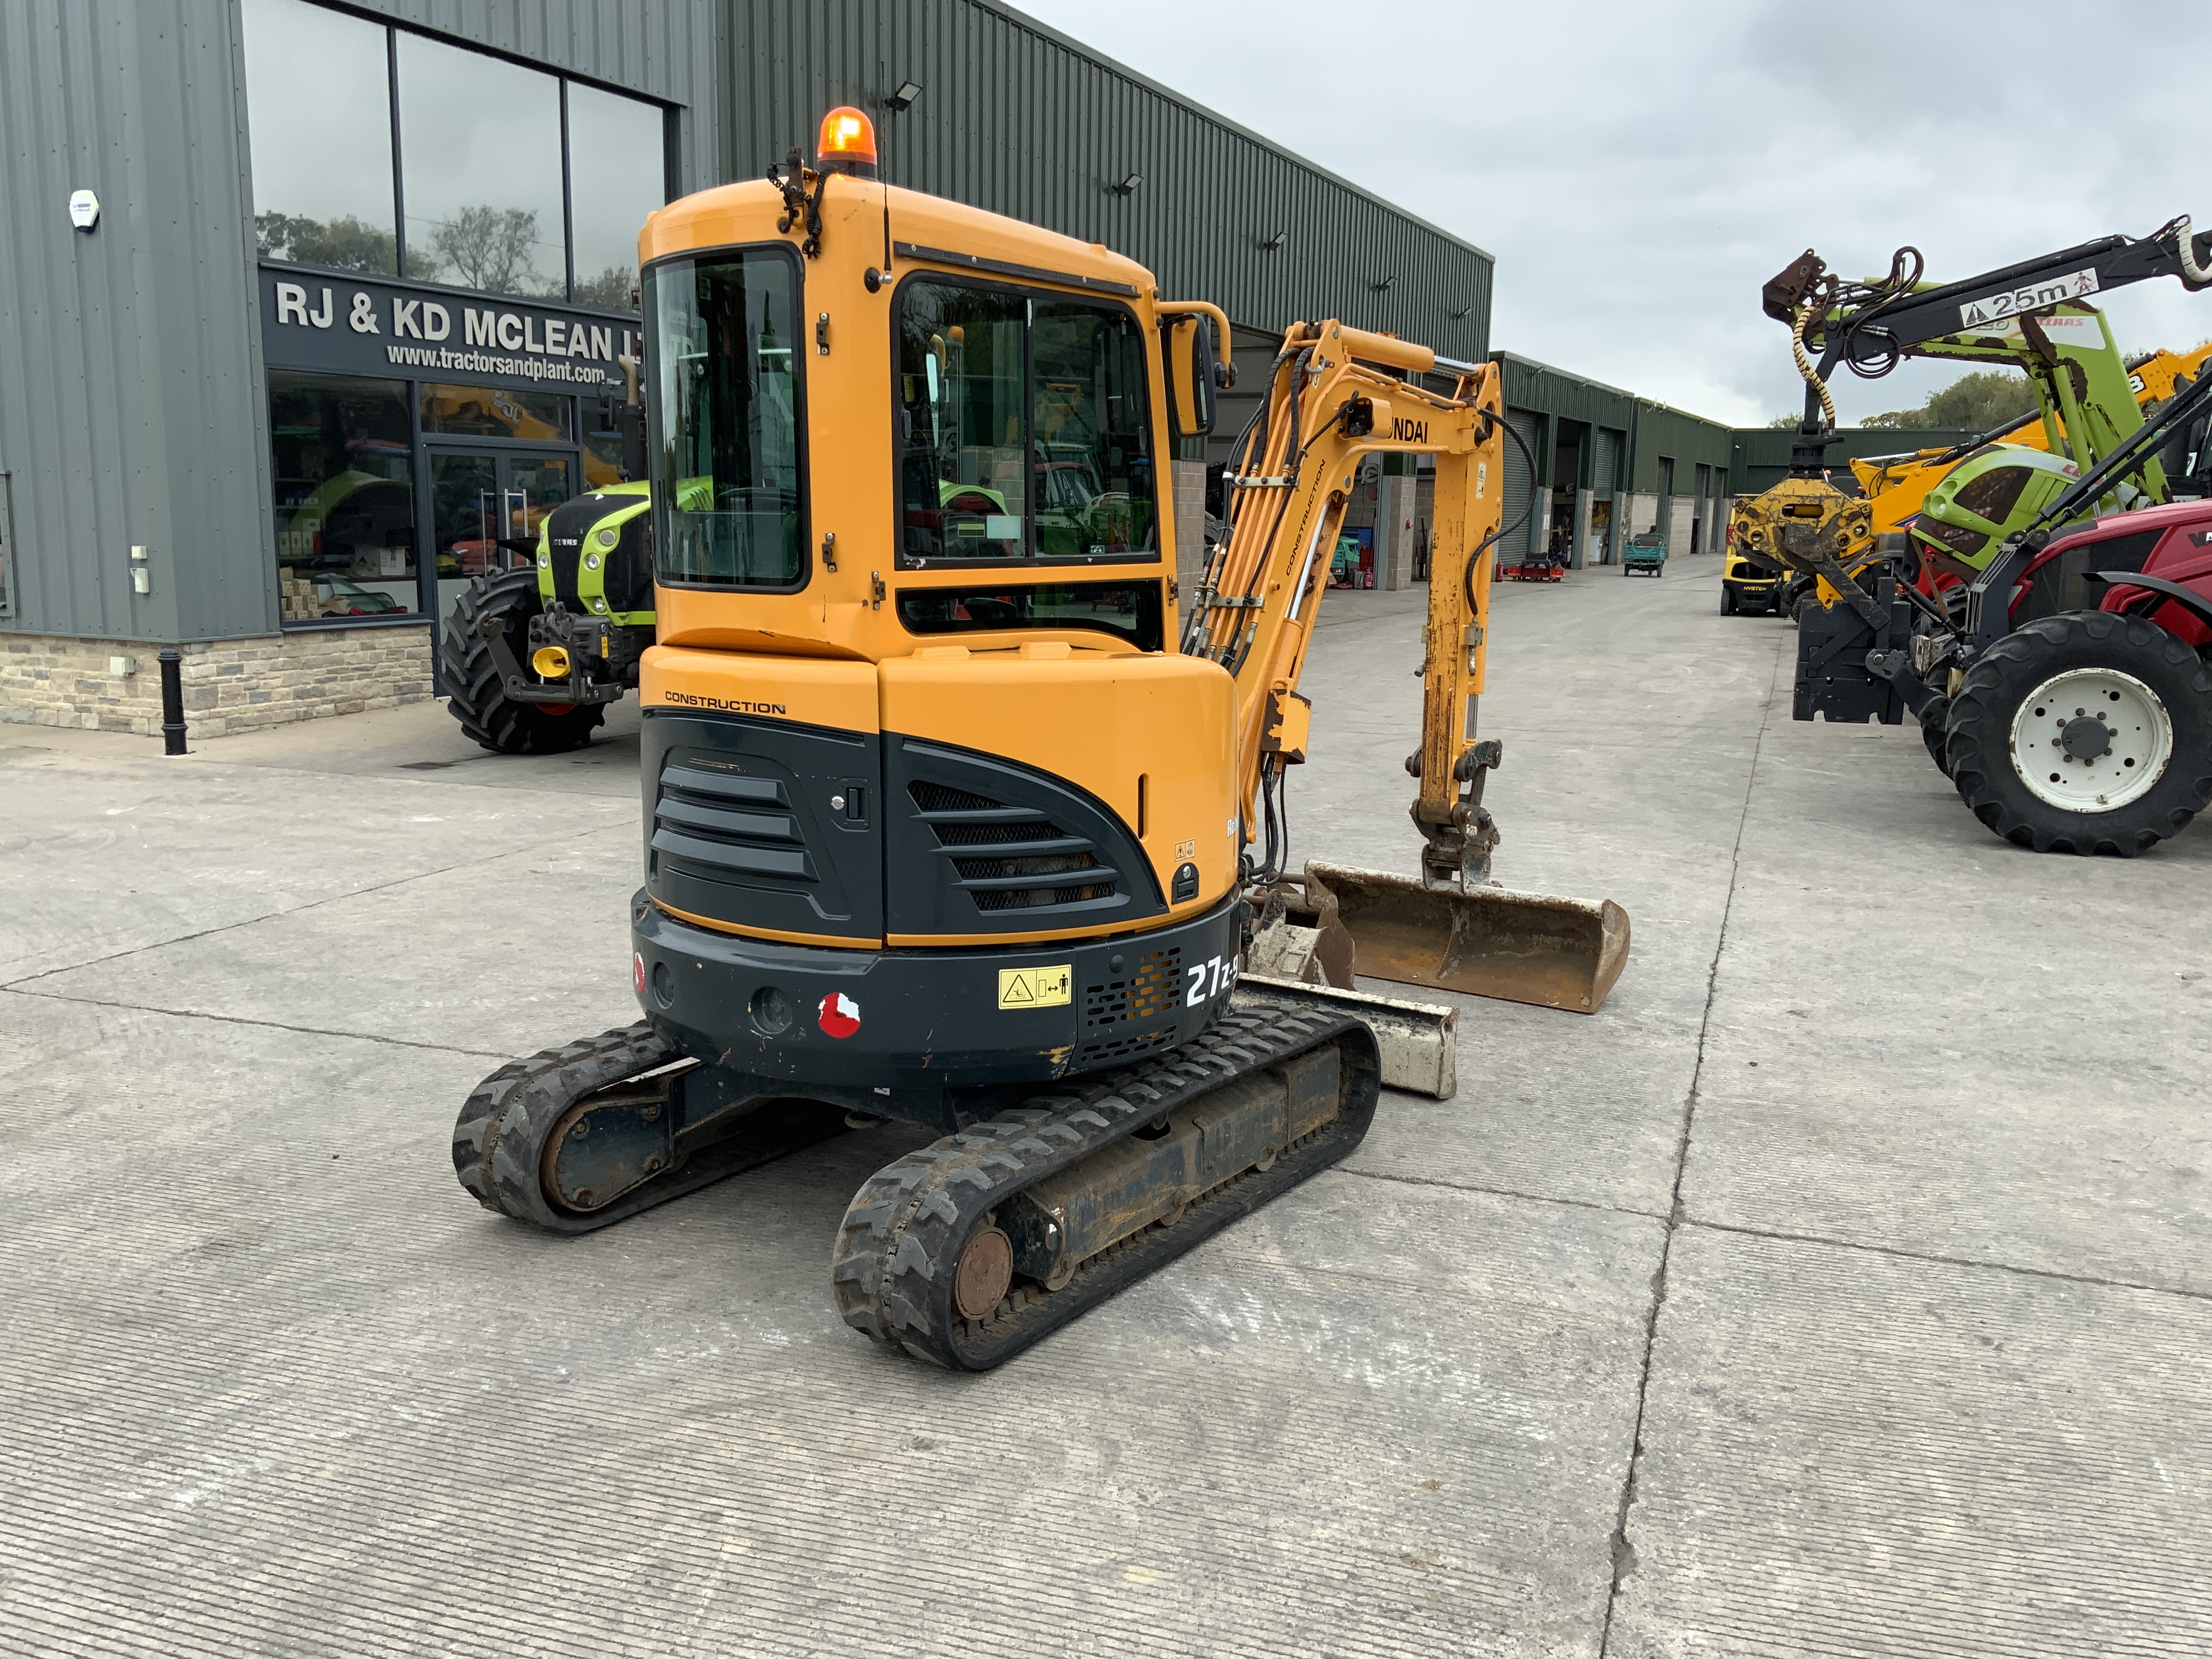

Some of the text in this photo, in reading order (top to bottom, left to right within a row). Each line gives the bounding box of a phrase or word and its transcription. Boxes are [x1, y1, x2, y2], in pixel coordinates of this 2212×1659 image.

[1993, 284, 2067, 317] 25m
[276, 282, 333, 329] RJ
[349, 292, 381, 334] &
[393, 298, 451, 341] KD
[464, 308, 613, 362] MCLEAN
[2038, 318, 2084, 326] CLAAS
[387, 345, 605, 383] www.tractorsandplant.com
[1286, 459, 1326, 577] CONSTRUCTION
[665, 691, 786, 714] CONSTRUCTION
